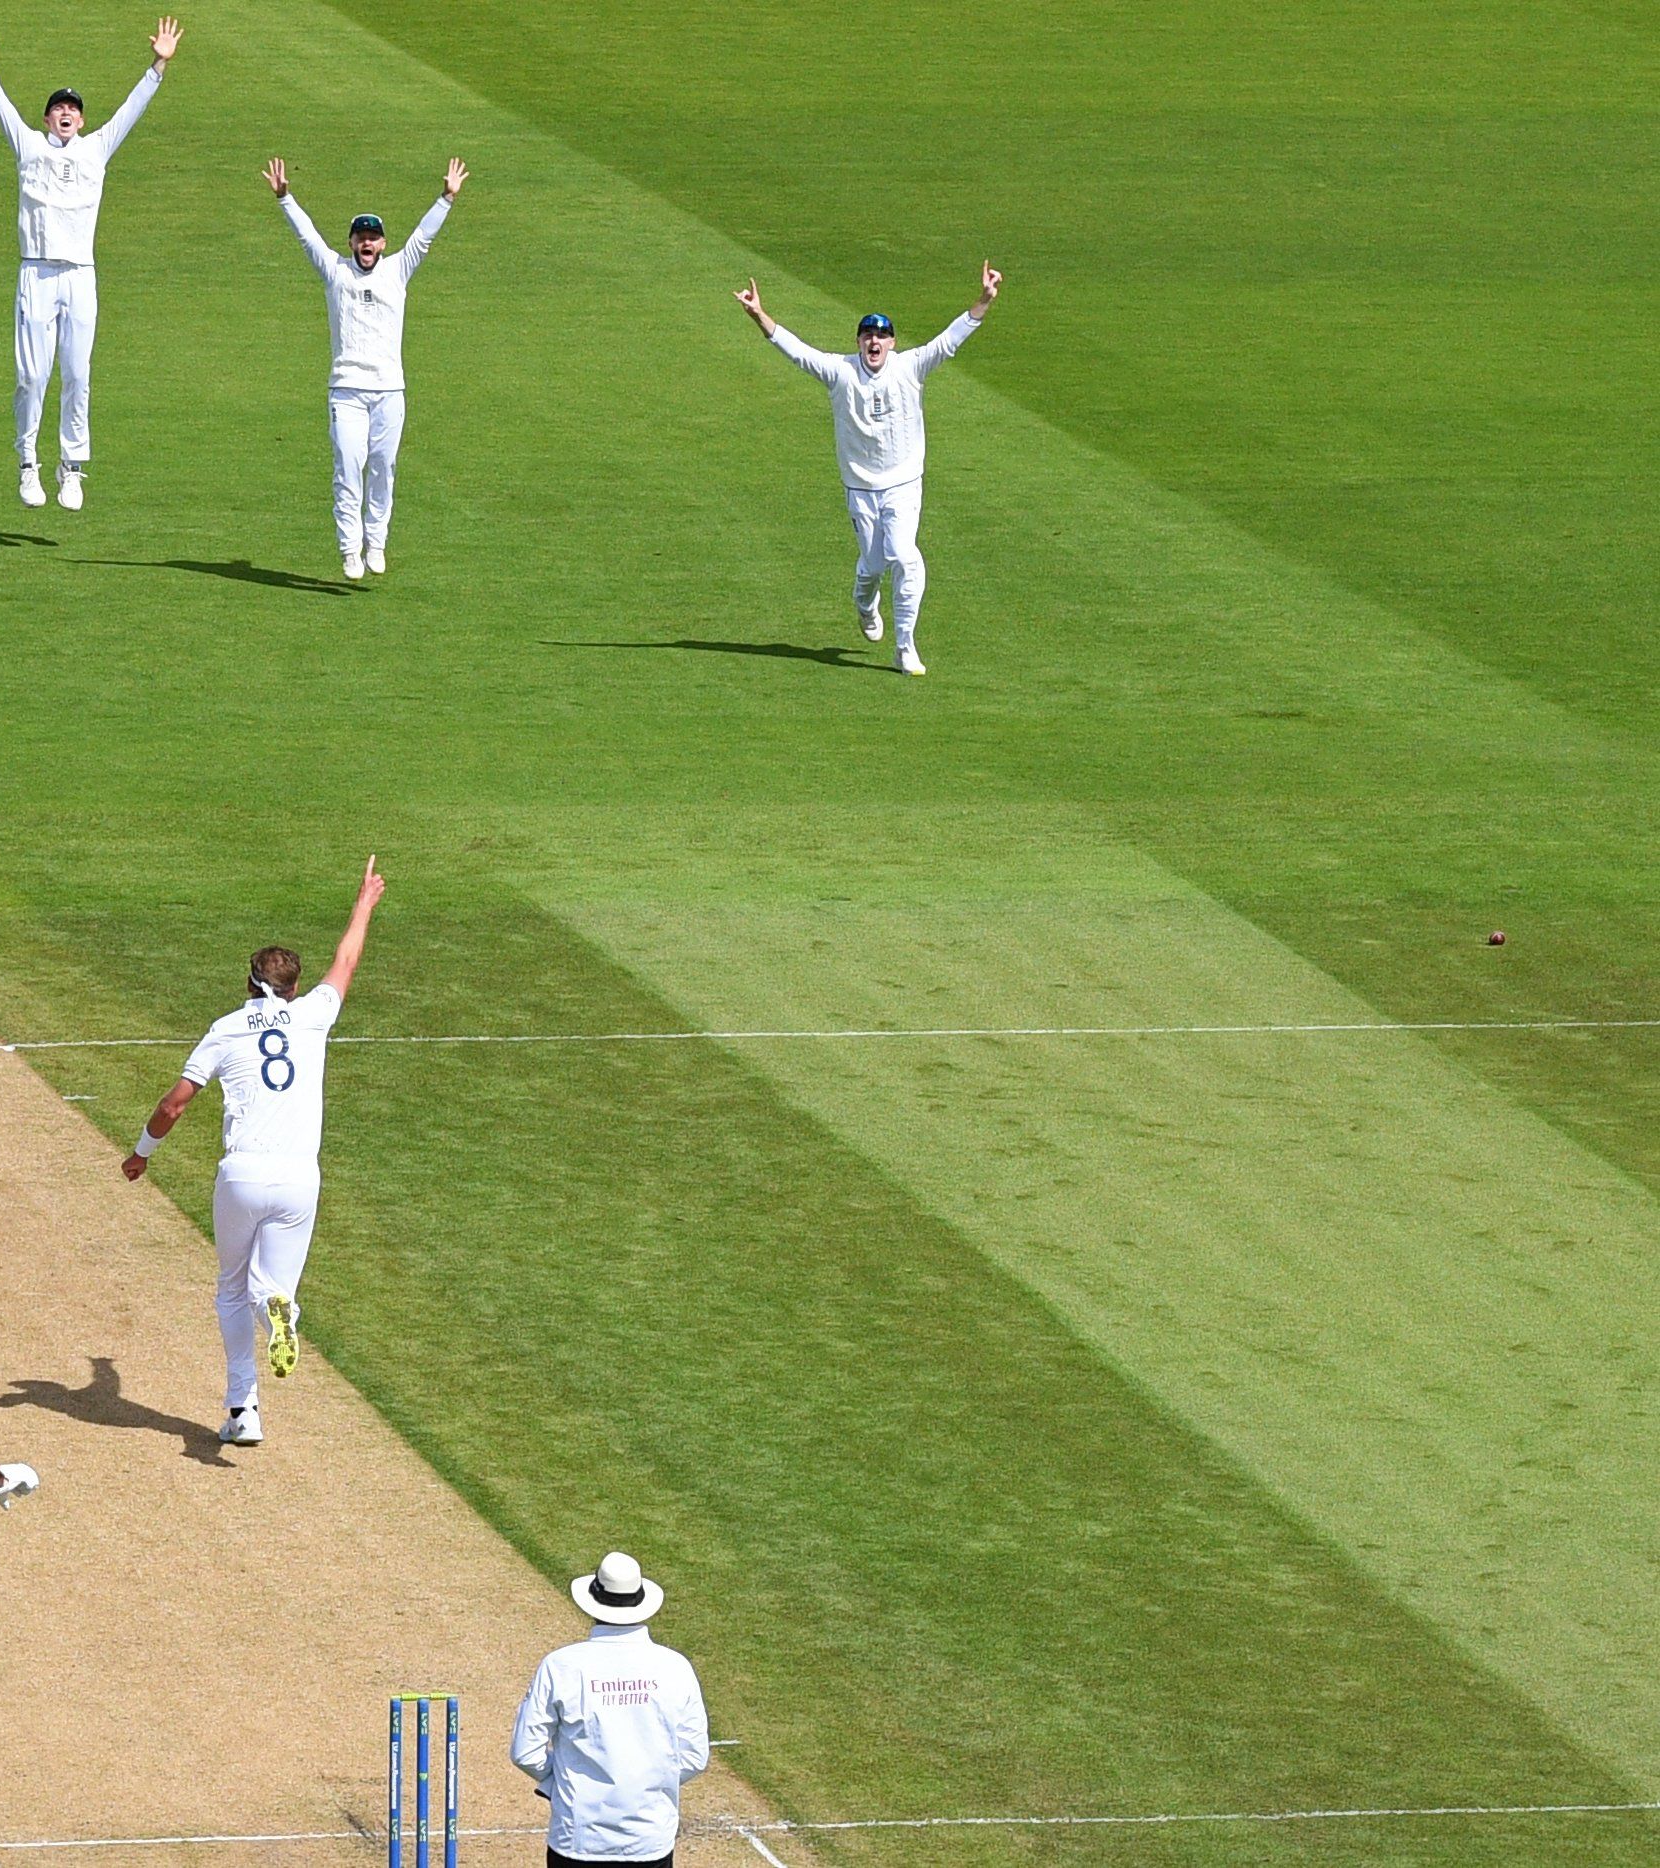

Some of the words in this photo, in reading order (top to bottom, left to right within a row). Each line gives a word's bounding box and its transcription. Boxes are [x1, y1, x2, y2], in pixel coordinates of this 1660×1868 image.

[258, 1028, 295, 1092] 8
[590, 1677, 658, 1693] Emirates
[602, 1695, 616, 1706] FLY
[619, 1693, 649, 1706] BETTER
